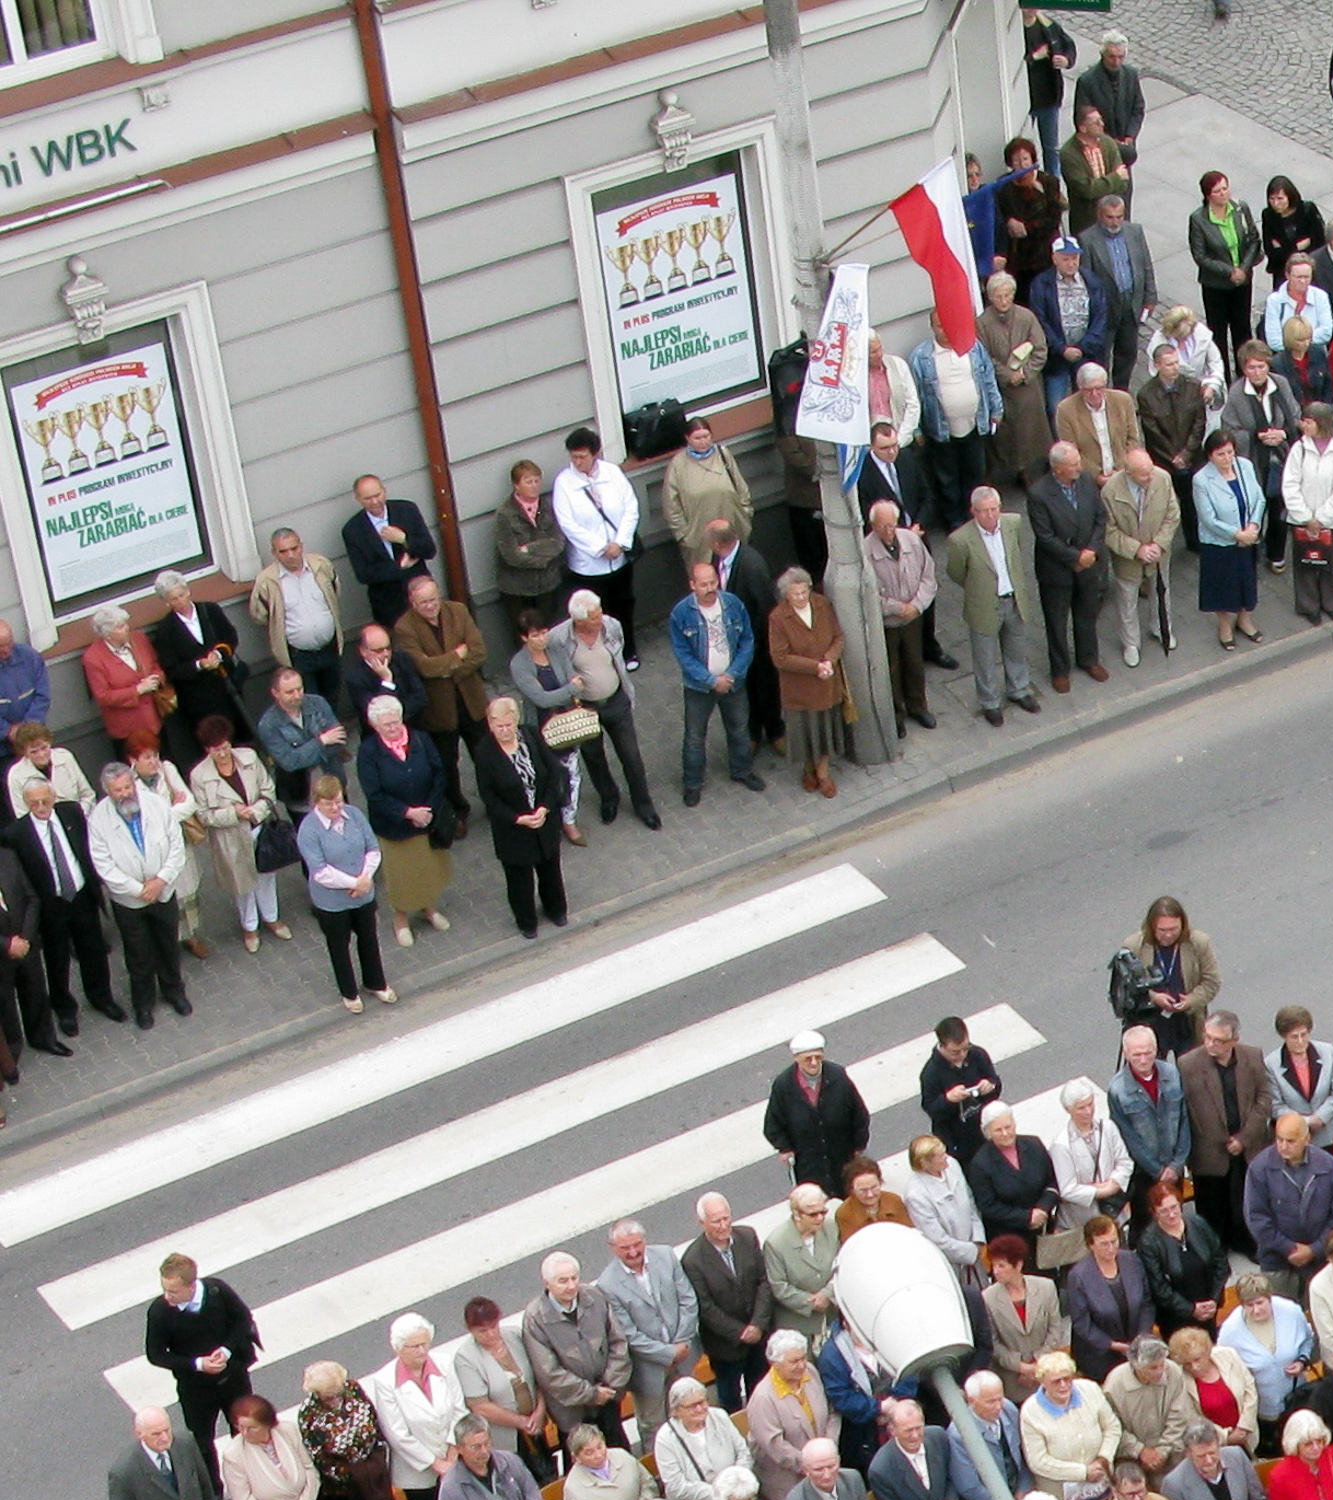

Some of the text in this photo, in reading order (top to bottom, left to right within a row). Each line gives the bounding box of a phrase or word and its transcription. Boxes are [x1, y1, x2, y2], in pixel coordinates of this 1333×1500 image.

[30, 118, 138, 177] WBK
[620, 325, 681, 360] NAJLEPSI
[648, 332, 711, 370] ZARABIAĆ
[46, 500, 113, 537] NAJLEPSI
[77, 507, 147, 548] ZARABIAĆ
